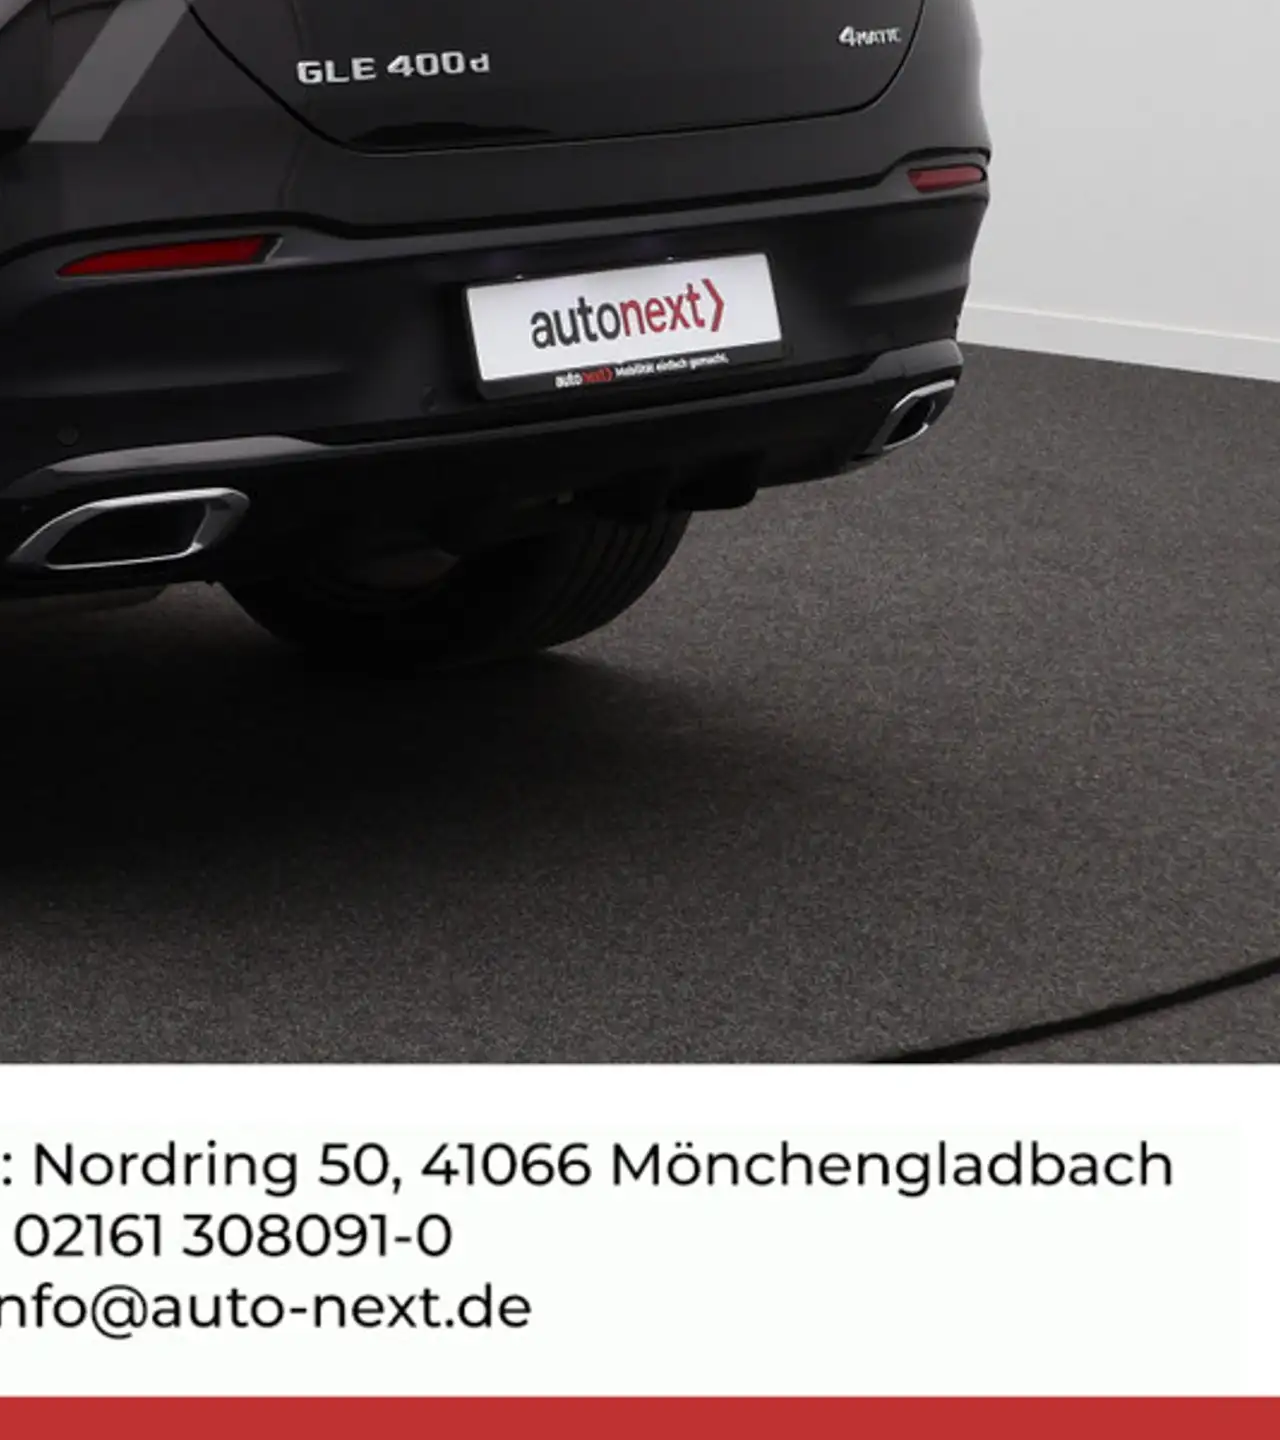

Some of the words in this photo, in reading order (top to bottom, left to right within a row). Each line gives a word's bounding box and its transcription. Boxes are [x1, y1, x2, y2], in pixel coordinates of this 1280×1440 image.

[297, 58, 376, 84] GLE
[387, 51, 490, 77] 400d
[529, 283, 705, 349] autonext
